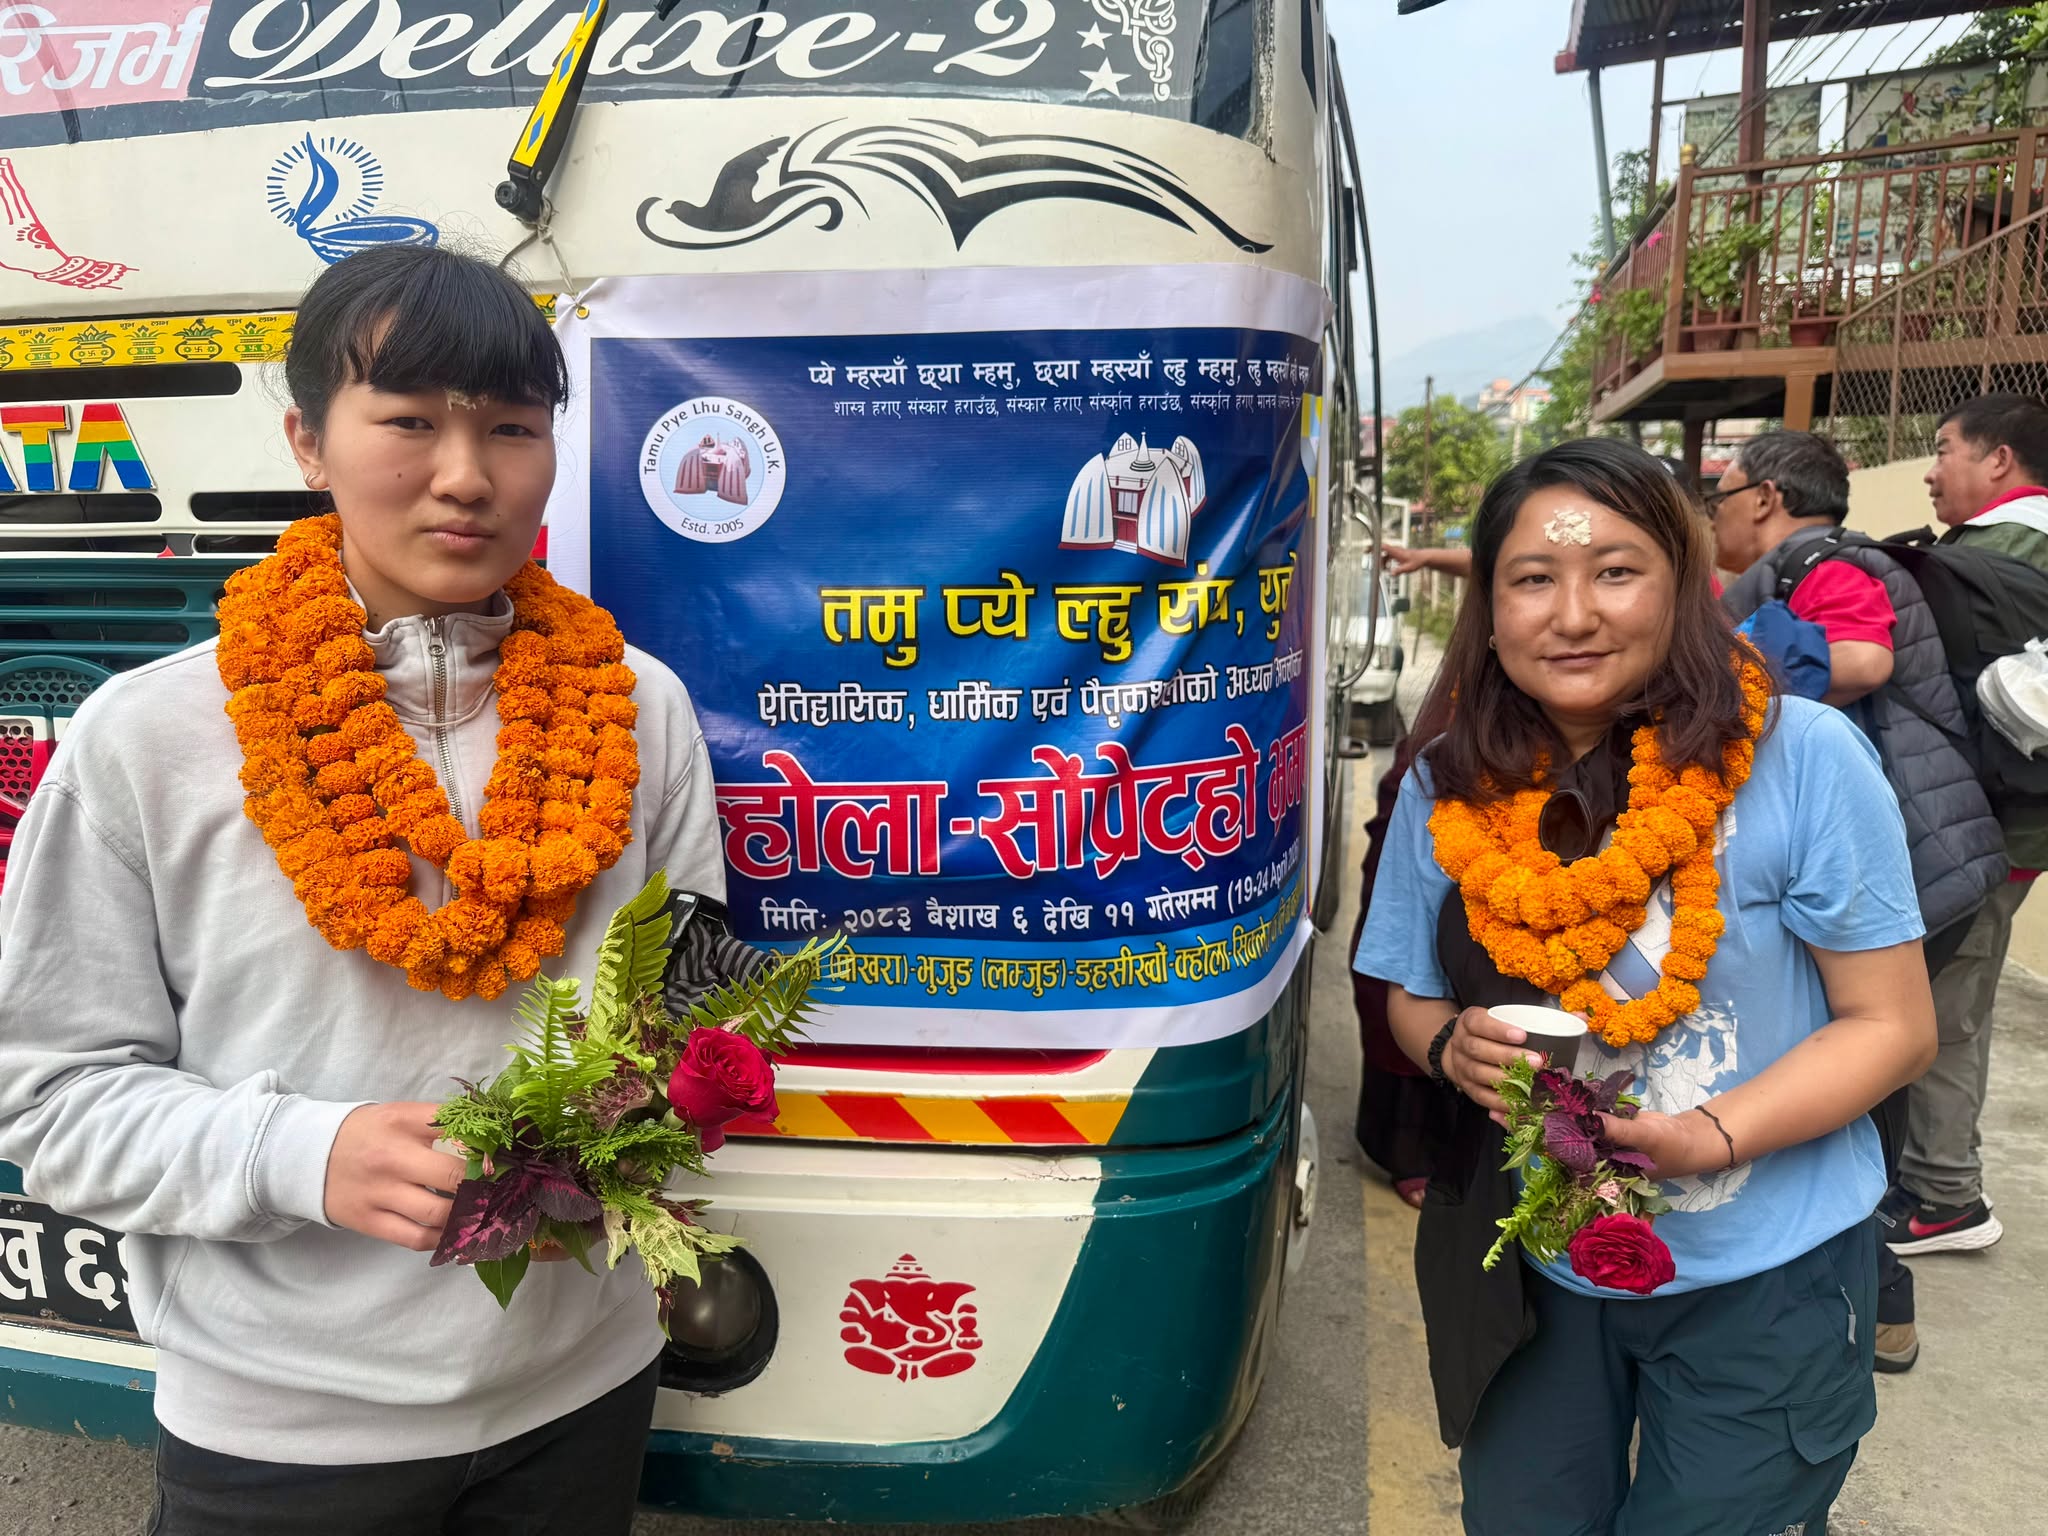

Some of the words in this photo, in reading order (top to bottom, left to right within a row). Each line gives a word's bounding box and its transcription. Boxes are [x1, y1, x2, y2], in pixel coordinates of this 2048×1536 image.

[204, 0, 1056, 88] Deluxe-2
[808, 360, 836, 386] प्ये
[845, 354, 908, 390] म्हस्याँ
[972, 361, 1021, 391] म्हमु,
[1090, 349, 1153, 383] म्हस्याँ
[1163, 358, 1188, 387] ल्हु
[1198, 358, 1241, 387] म्हमु,
[1247, 359, 1262, 387] ल्हु
[834, 400, 866, 416] शास्त्र
[872, 400, 902, 419] हराए
[907, 396, 948, 416] संस्कार
[1006, 395, 1047, 414] संस्कार
[1053, 395, 1083, 415] हराए
[1089, 390, 1132, 416] संस्कृति
[1190, 389, 1231, 416] संस्कृति
[643, 433, 665, 475] Tamu
[661, 410, 689, 432] Pye
[692, 401, 721, 416] Lhu
[725, 404, 766, 440] Sangh
[762, 441, 780, 475] U.K.
[681, 517, 710, 534] Estd.
[715, 518, 744, 534] 2005
[820, 586, 925, 669] तमु
[942, 570, 1036, 639] प्ये
[1054, 584, 1143, 662] ल्हु
[757, 683, 916, 730] ऐतिहासिक,
[928, 681, 1023, 721] धार्मिक
[1031, 677, 1073, 722] एवं
[759, 897, 827, 930] मिति:
[843, 906, 912, 933] २०८३
[926, 897, 1000, 930] बैशाख
[1012, 905, 1029, 934] ६
[1042, 897, 1093, 934] देखि
[1104, 901, 1134, 928] ११
[1144, 885, 1219, 922] गतेसम्म
[1227, 872, 1269, 914] (19-24
